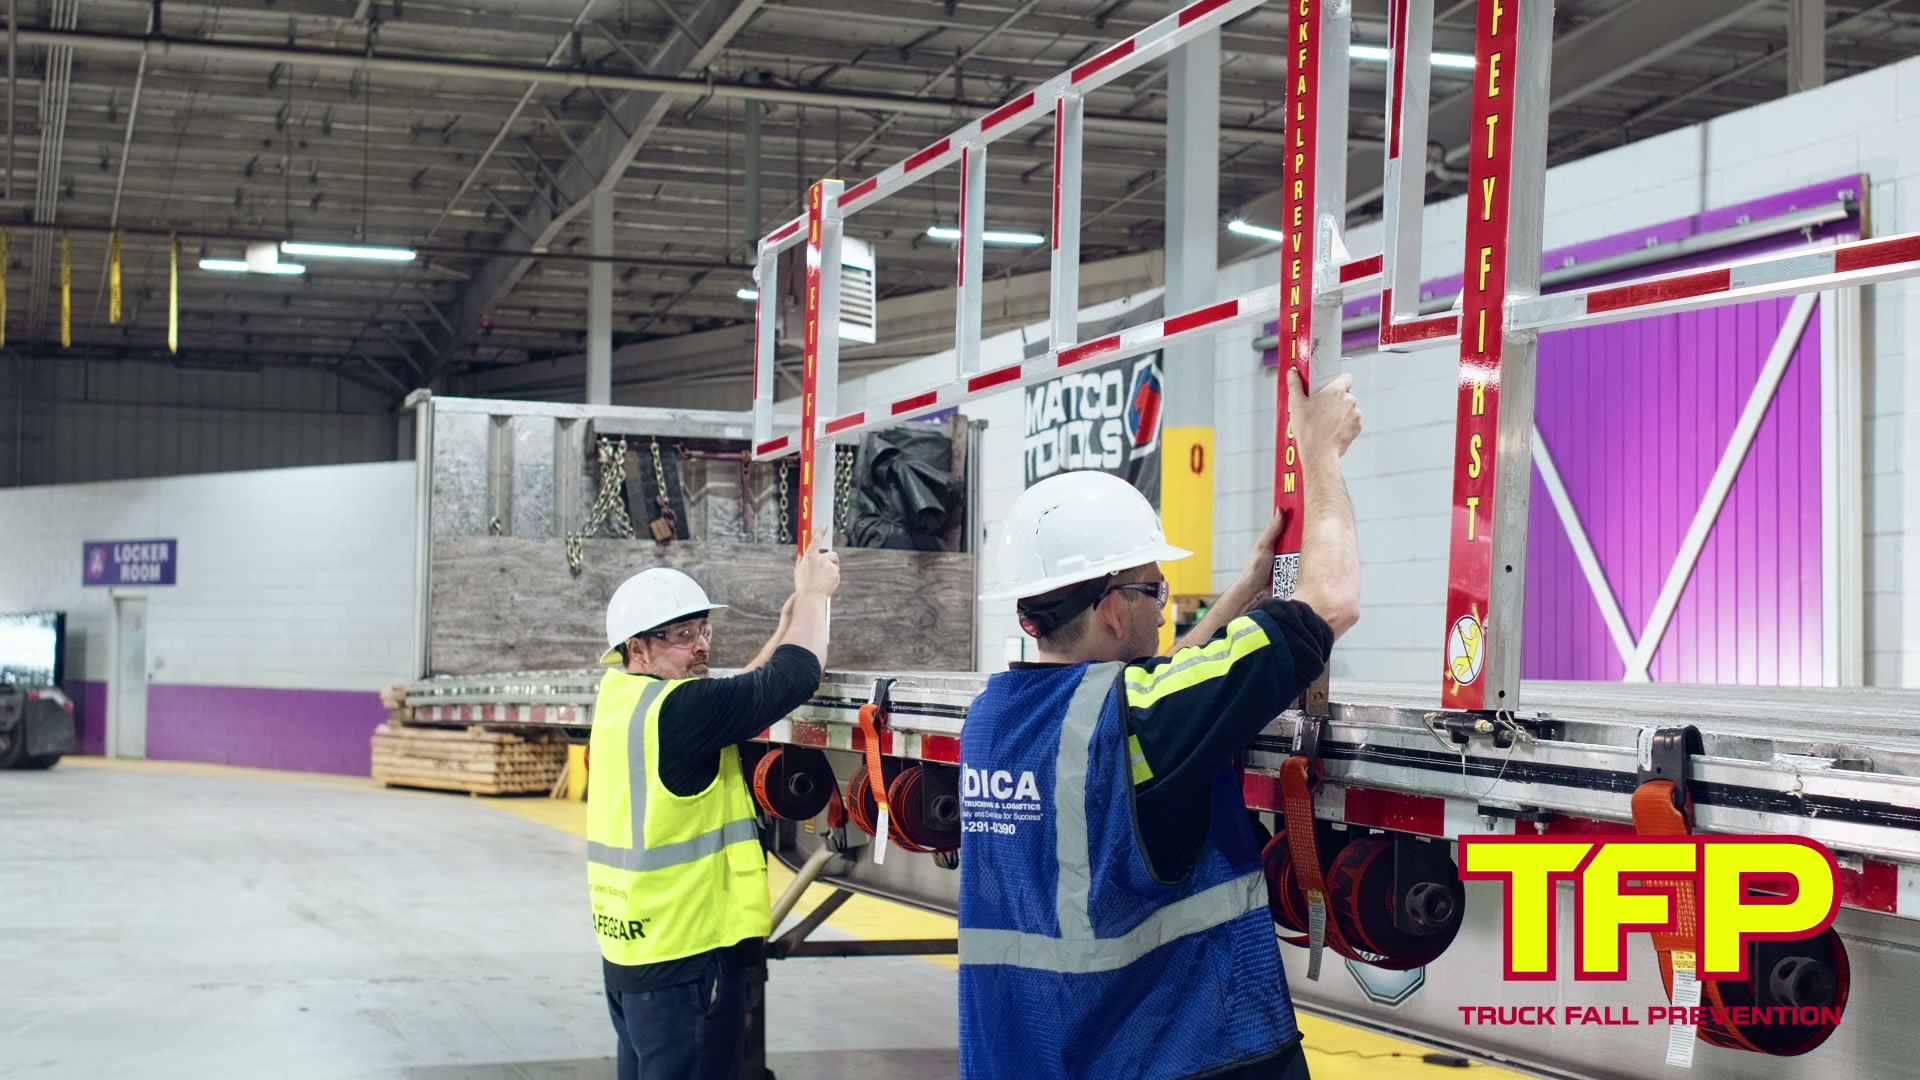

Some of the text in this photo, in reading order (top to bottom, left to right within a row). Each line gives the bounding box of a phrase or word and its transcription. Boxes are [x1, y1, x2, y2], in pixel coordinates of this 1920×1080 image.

[1025, 368, 1124, 437] MATCO
[1466, 245, 1493, 541] FIRST
[1025, 418, 1124, 482] TOOLS
[802, 392, 812, 554] FIRST
[113, 543, 169, 563] LOCKER
[120, 562, 161, 582] ROOM
[964, 800, 994, 809] TRUCKING
[1002, 802, 1042, 811] LOGISTICS
[1003, 812, 1012, 820] for
